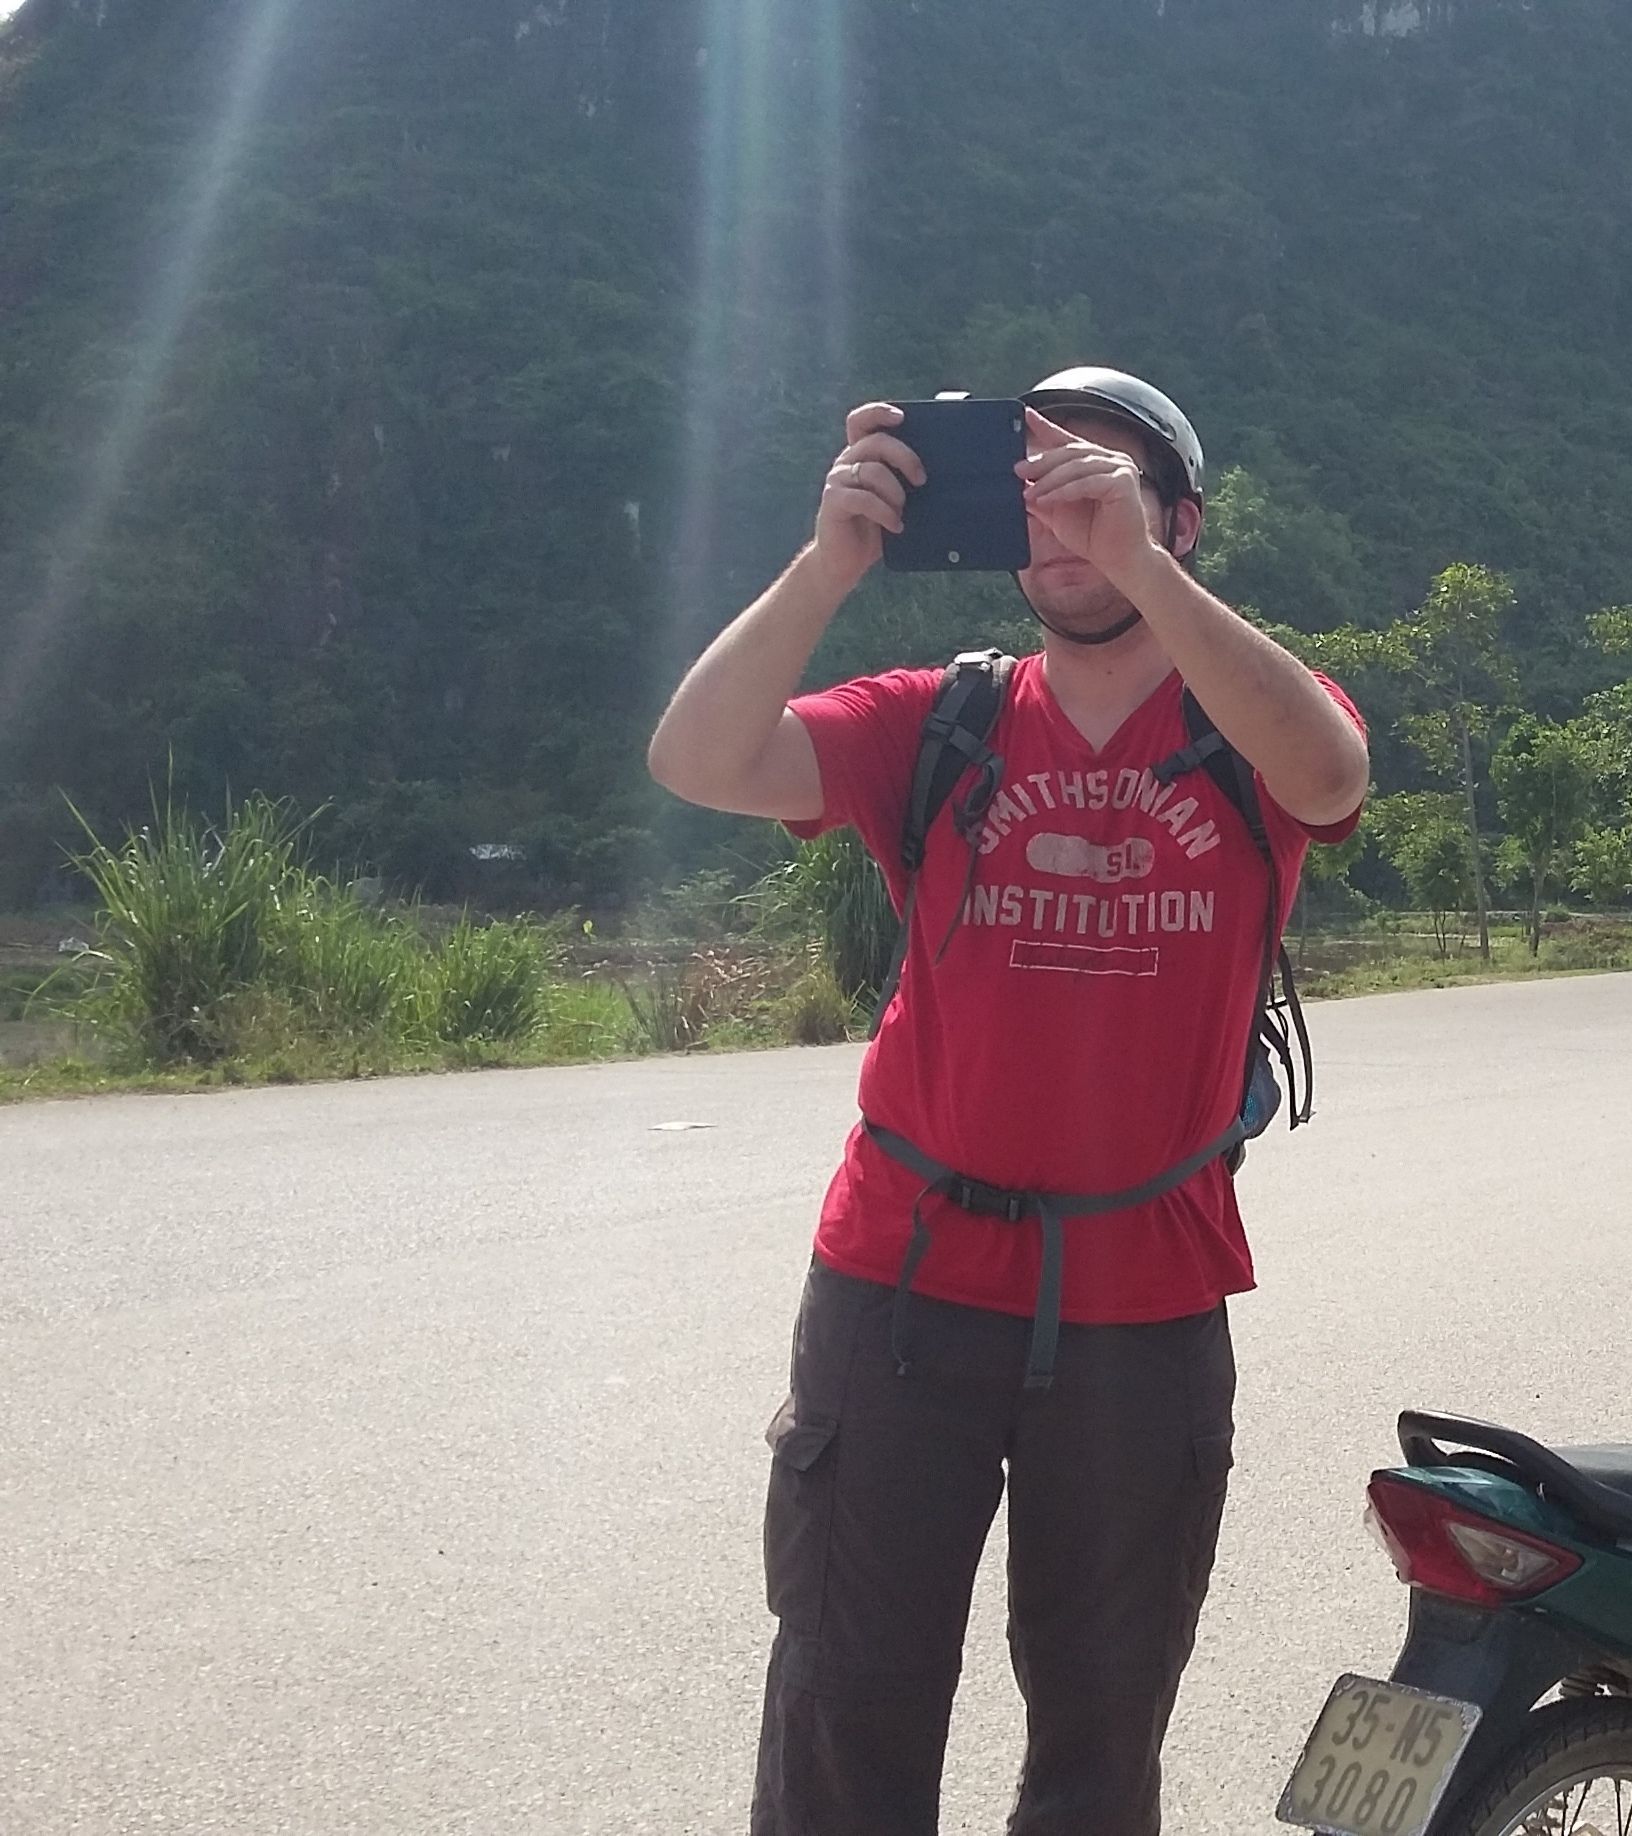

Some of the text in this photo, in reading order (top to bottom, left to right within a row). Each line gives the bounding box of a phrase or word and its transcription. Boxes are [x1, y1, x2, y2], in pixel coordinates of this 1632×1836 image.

[962, 885, 1214, 937] INSTITUTION
[1333, 1691, 1451, 1767] 35-N5
[1304, 1755, 1418, 1833] 3080
